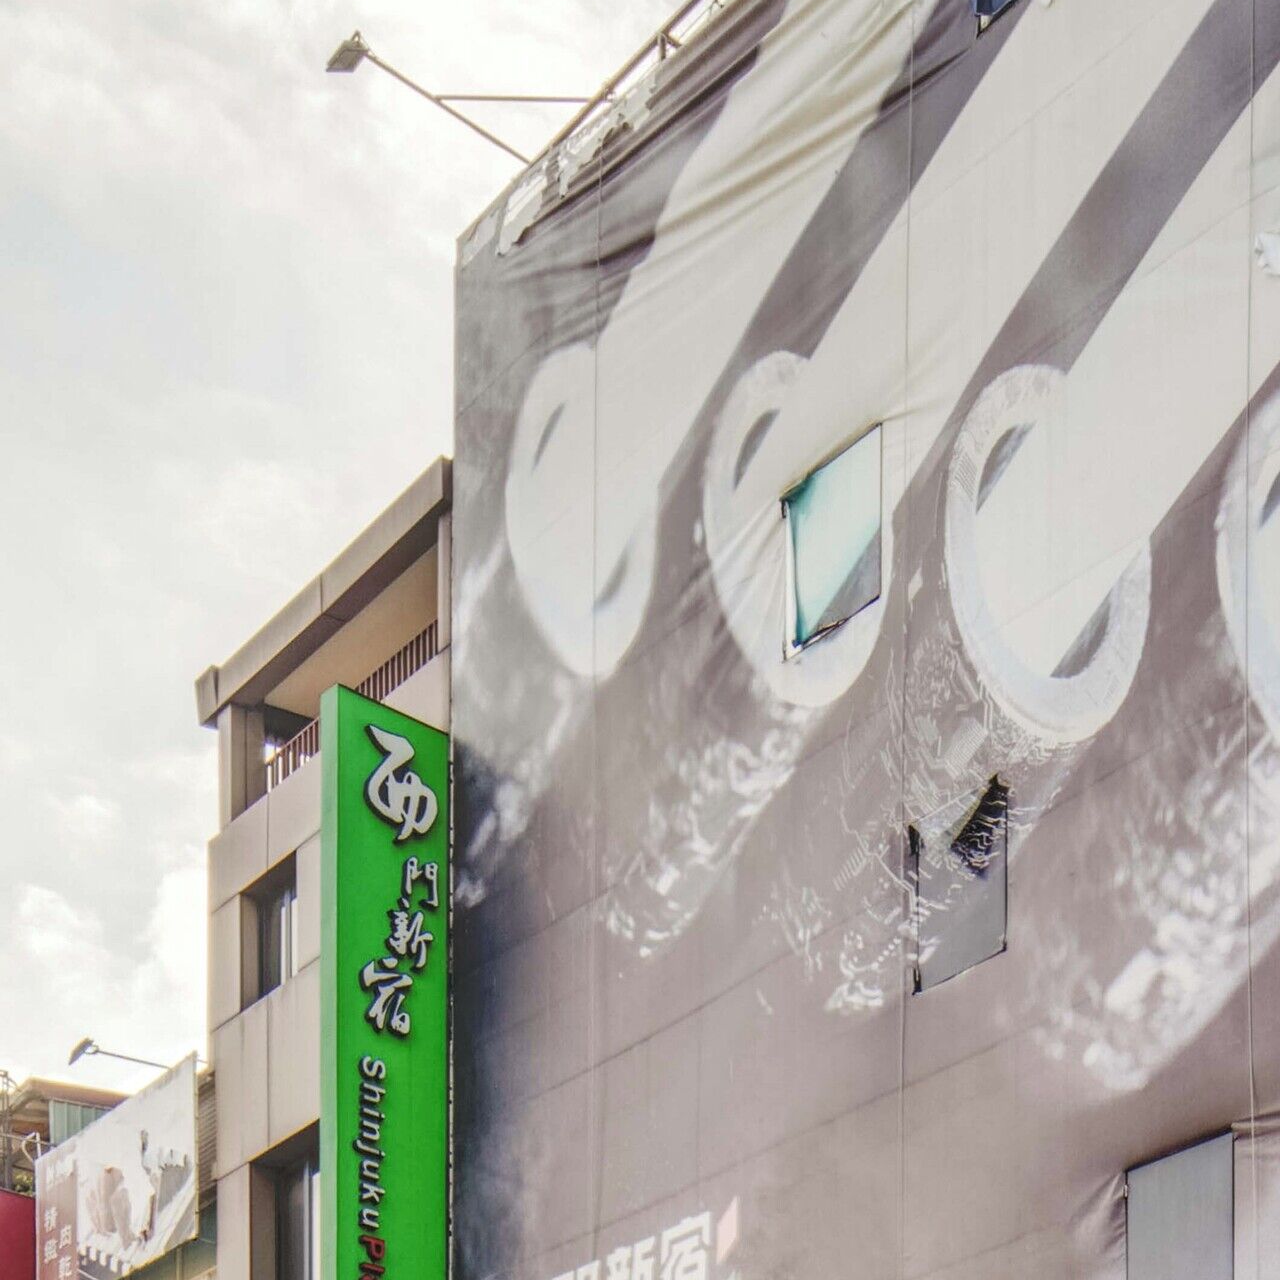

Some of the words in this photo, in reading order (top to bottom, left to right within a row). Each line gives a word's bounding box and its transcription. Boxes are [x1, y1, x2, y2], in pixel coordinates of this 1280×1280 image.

[360, 723, 439, 1036] 西門新宿
[354, 1055, 386, 1229] Shinjuku
